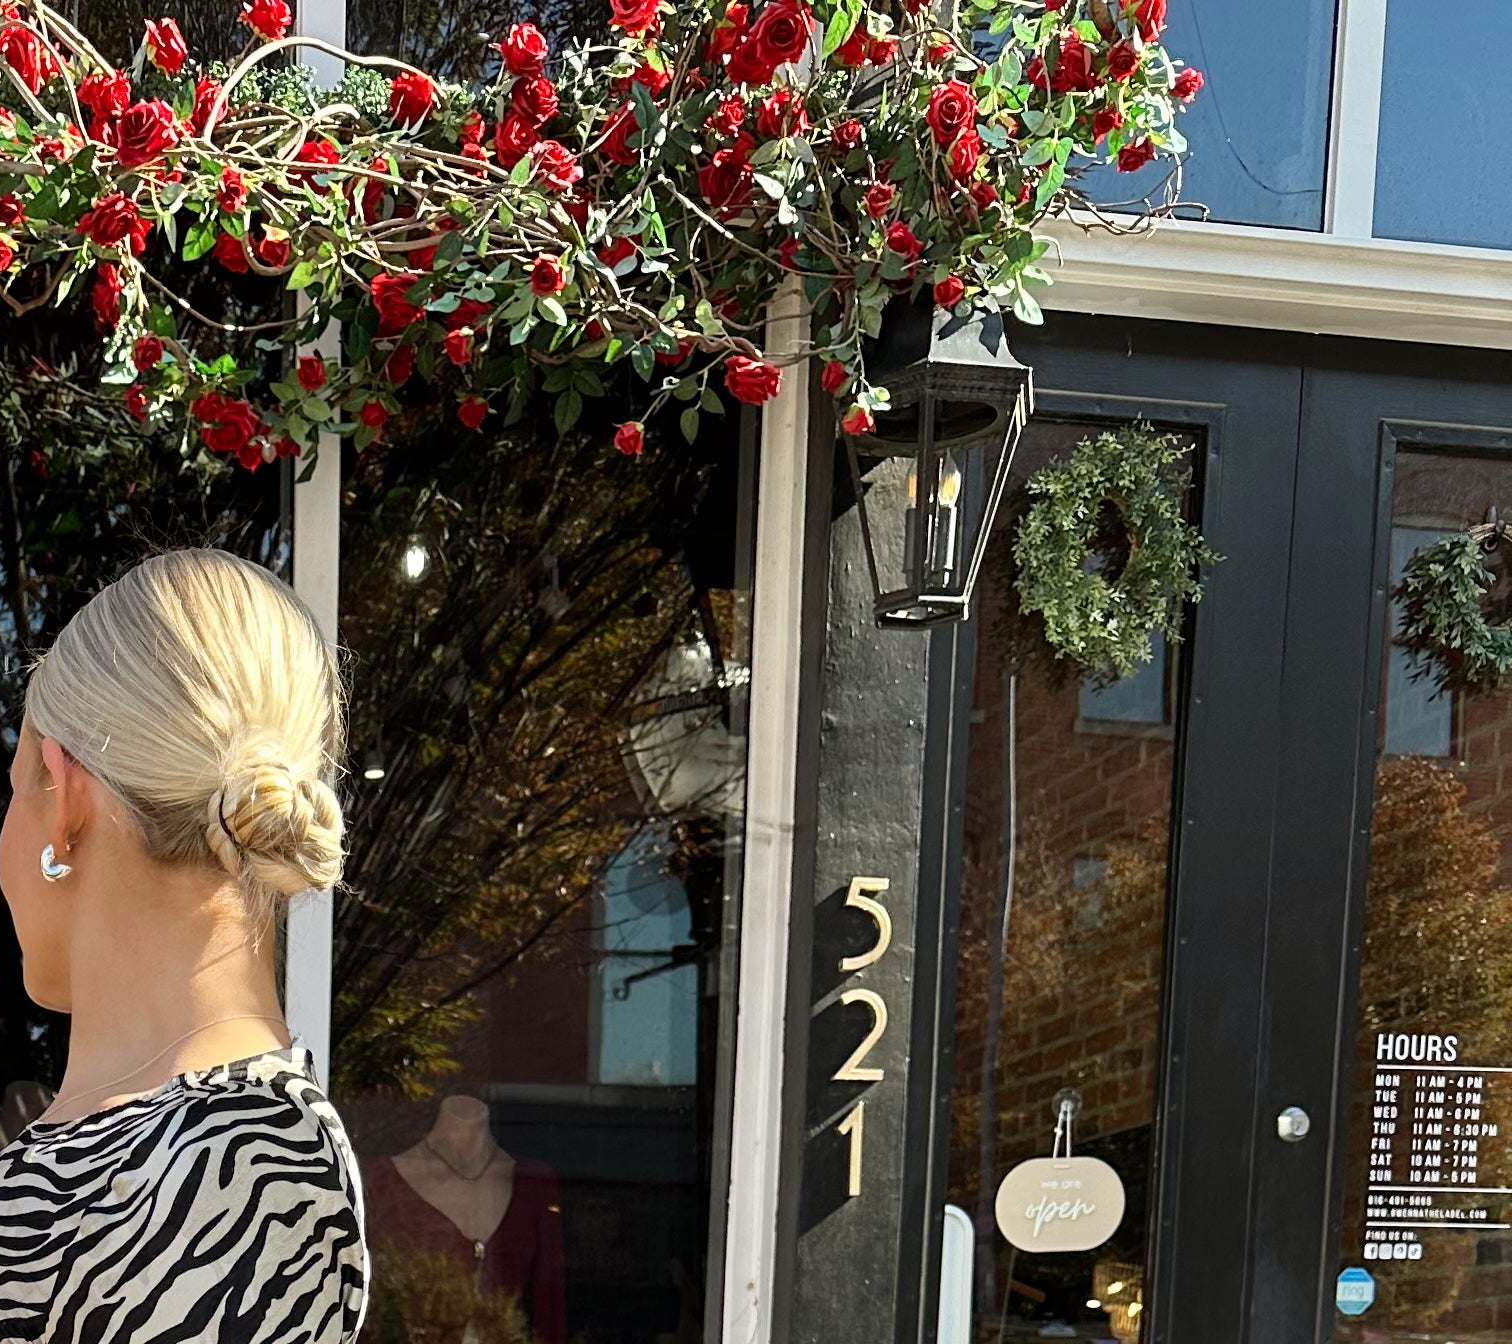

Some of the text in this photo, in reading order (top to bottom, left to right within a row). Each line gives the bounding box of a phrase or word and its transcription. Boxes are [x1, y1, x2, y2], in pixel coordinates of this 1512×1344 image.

[831, 876, 893, 1197] 521
[1377, 1034, 1457, 1061] HOURS
[1376, 1075, 1399, 1086] MON
[1417, 1076, 1425, 1087] 11
[1429, 1076, 1445, 1087] AM
[1457, 1077, 1463, 1087] 4
[1467, 1077, 1482, 1088] PM
[1376, 1090, 1397, 1102] TUE
[1416, 1091, 1424, 1103] 11
[1428, 1092, 1444, 1103] AM
[1465, 1093, 1480, 1104] PM
[1374, 1106, 1397, 1118] WED
[1415, 1108, 1423, 1118] 11
[1427, 1108, 1443, 1119] AM
[1464, 1108, 1480, 1120] PM
[1374, 1122, 1395, 1134] THU
[1414, 1123, 1422, 1134] 11
[1426, 1124, 1442, 1135] AM
[1482, 1124, 1497, 1136] PM
[1371, 1138, 1390, 1149] FRI
[1413, 1139, 1421, 1150] 11
[1425, 1139, 1441, 1150] AM
[1453, 1140, 1459, 1151] 7
[1462, 1140, 1477, 1151] PM
[1371, 1154, 1391, 1165] SAT
[1411, 1155, 1422, 1166] 10
[1425, 1155, 1441, 1166] AM
[1453, 1155, 1458, 1166] 7
[1462, 1156, 1477, 1167] PM
[1370, 1170, 1391, 1181] SUN
[1410, 1170, 1421, 1182] 10
[1424, 1171, 1440, 1182] AM
[1461, 1172, 1476, 1183] PM
[1025, 1195, 1096, 1238] open
